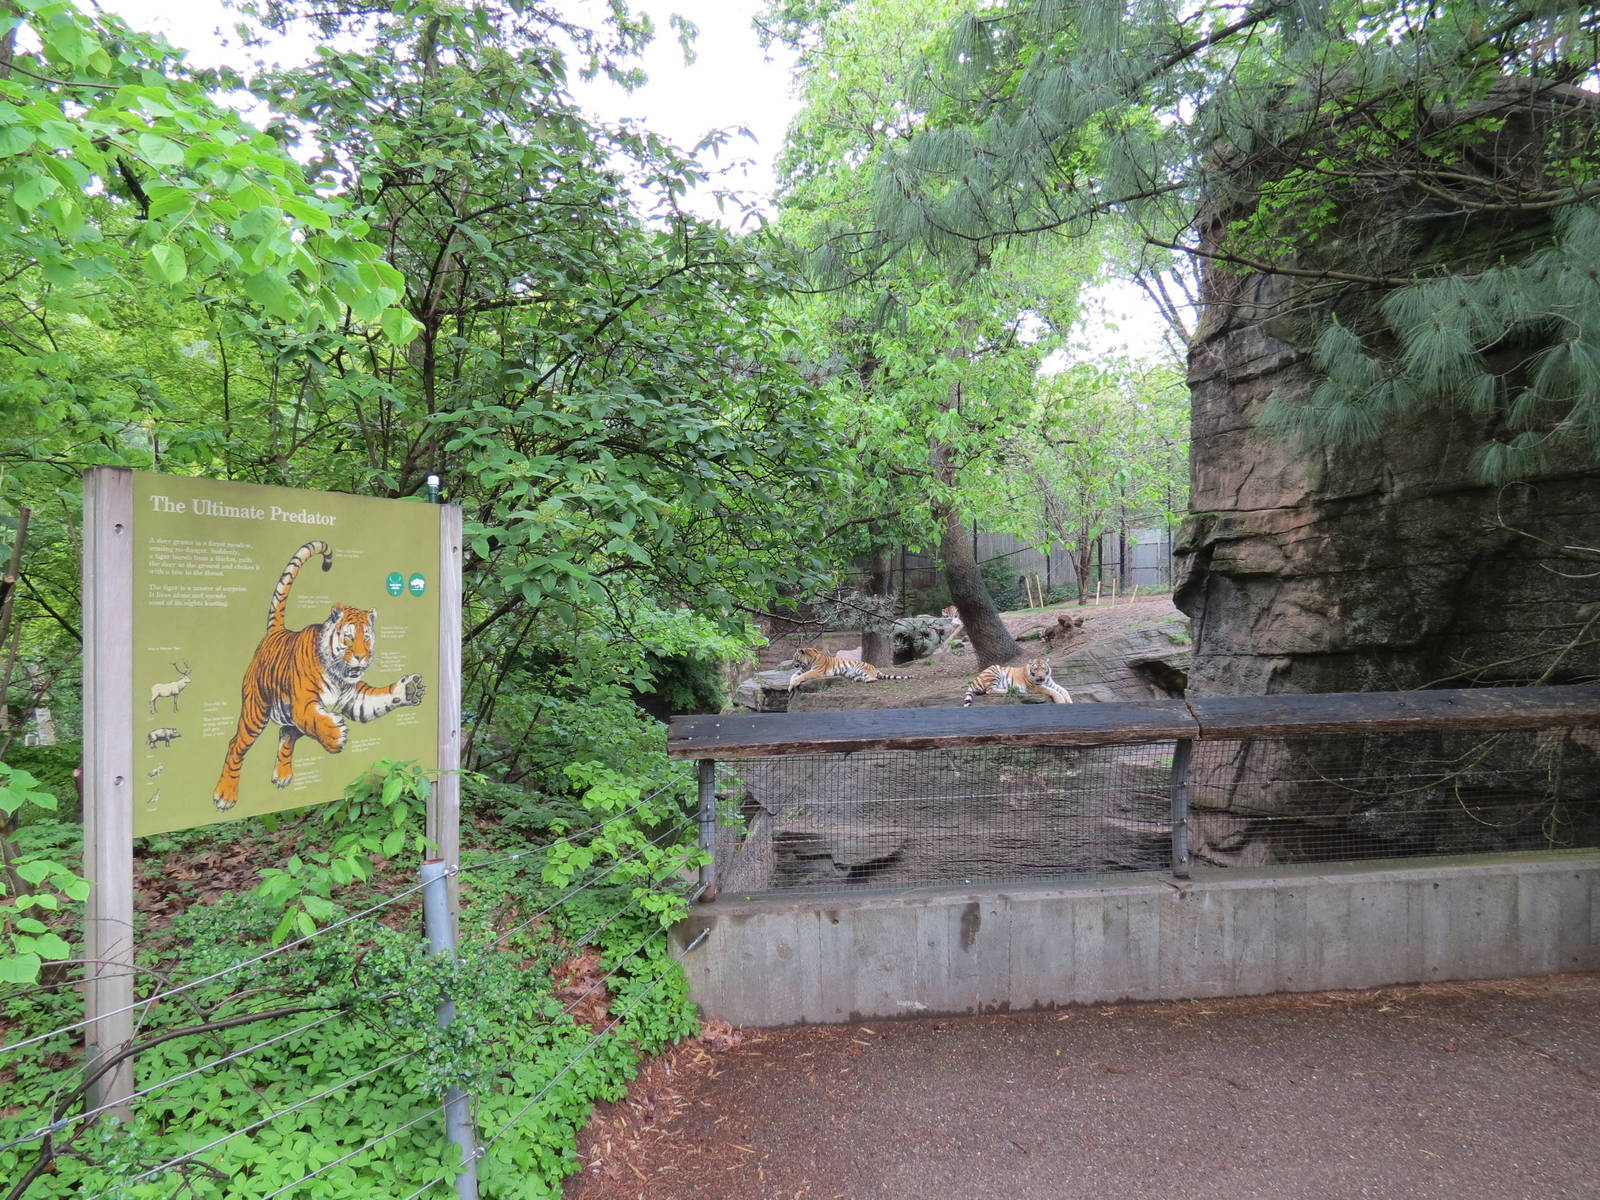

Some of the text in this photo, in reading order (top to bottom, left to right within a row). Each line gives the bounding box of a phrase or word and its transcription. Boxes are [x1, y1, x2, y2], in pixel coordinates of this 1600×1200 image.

[150, 494, 336, 525] The Ultimate Predator
